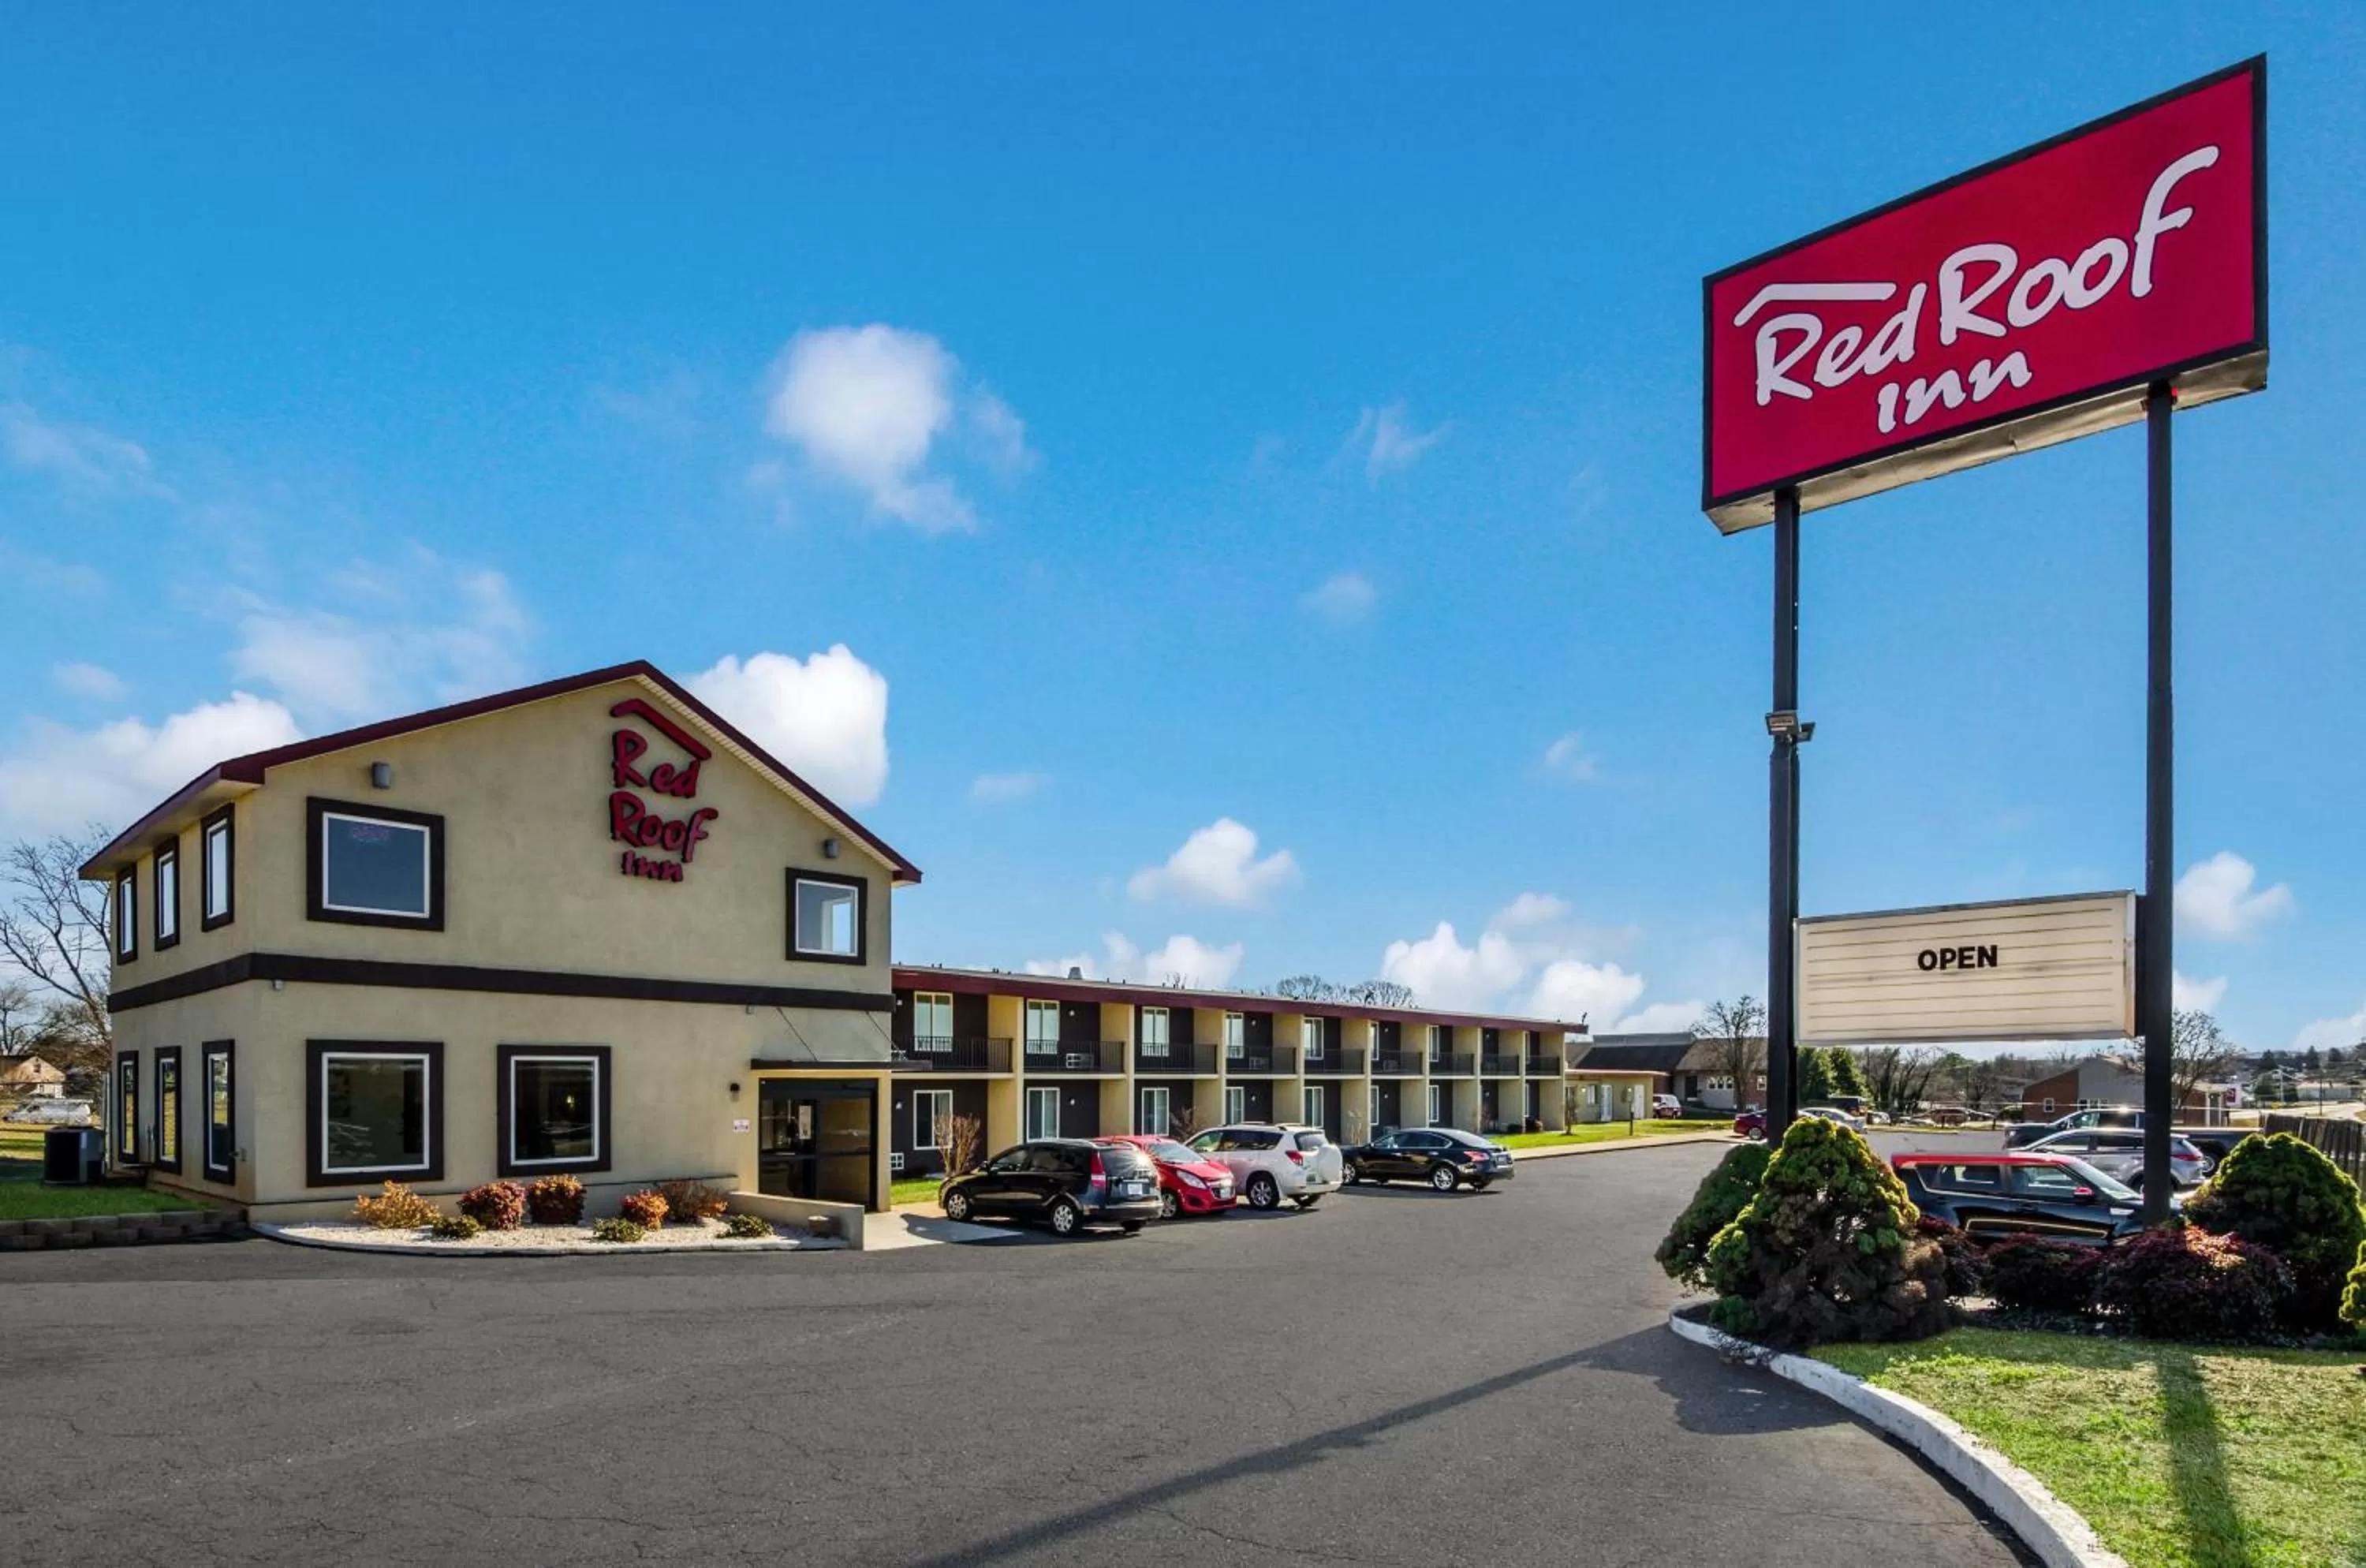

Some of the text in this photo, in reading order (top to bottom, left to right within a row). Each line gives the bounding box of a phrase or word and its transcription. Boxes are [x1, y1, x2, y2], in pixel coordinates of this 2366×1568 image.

[1756, 145, 2220, 406] Red Roof
[611, 729, 700, 798] Red
[609, 791, 718, 863] Roof
[1917, 944, 1998, 971] OPEN
